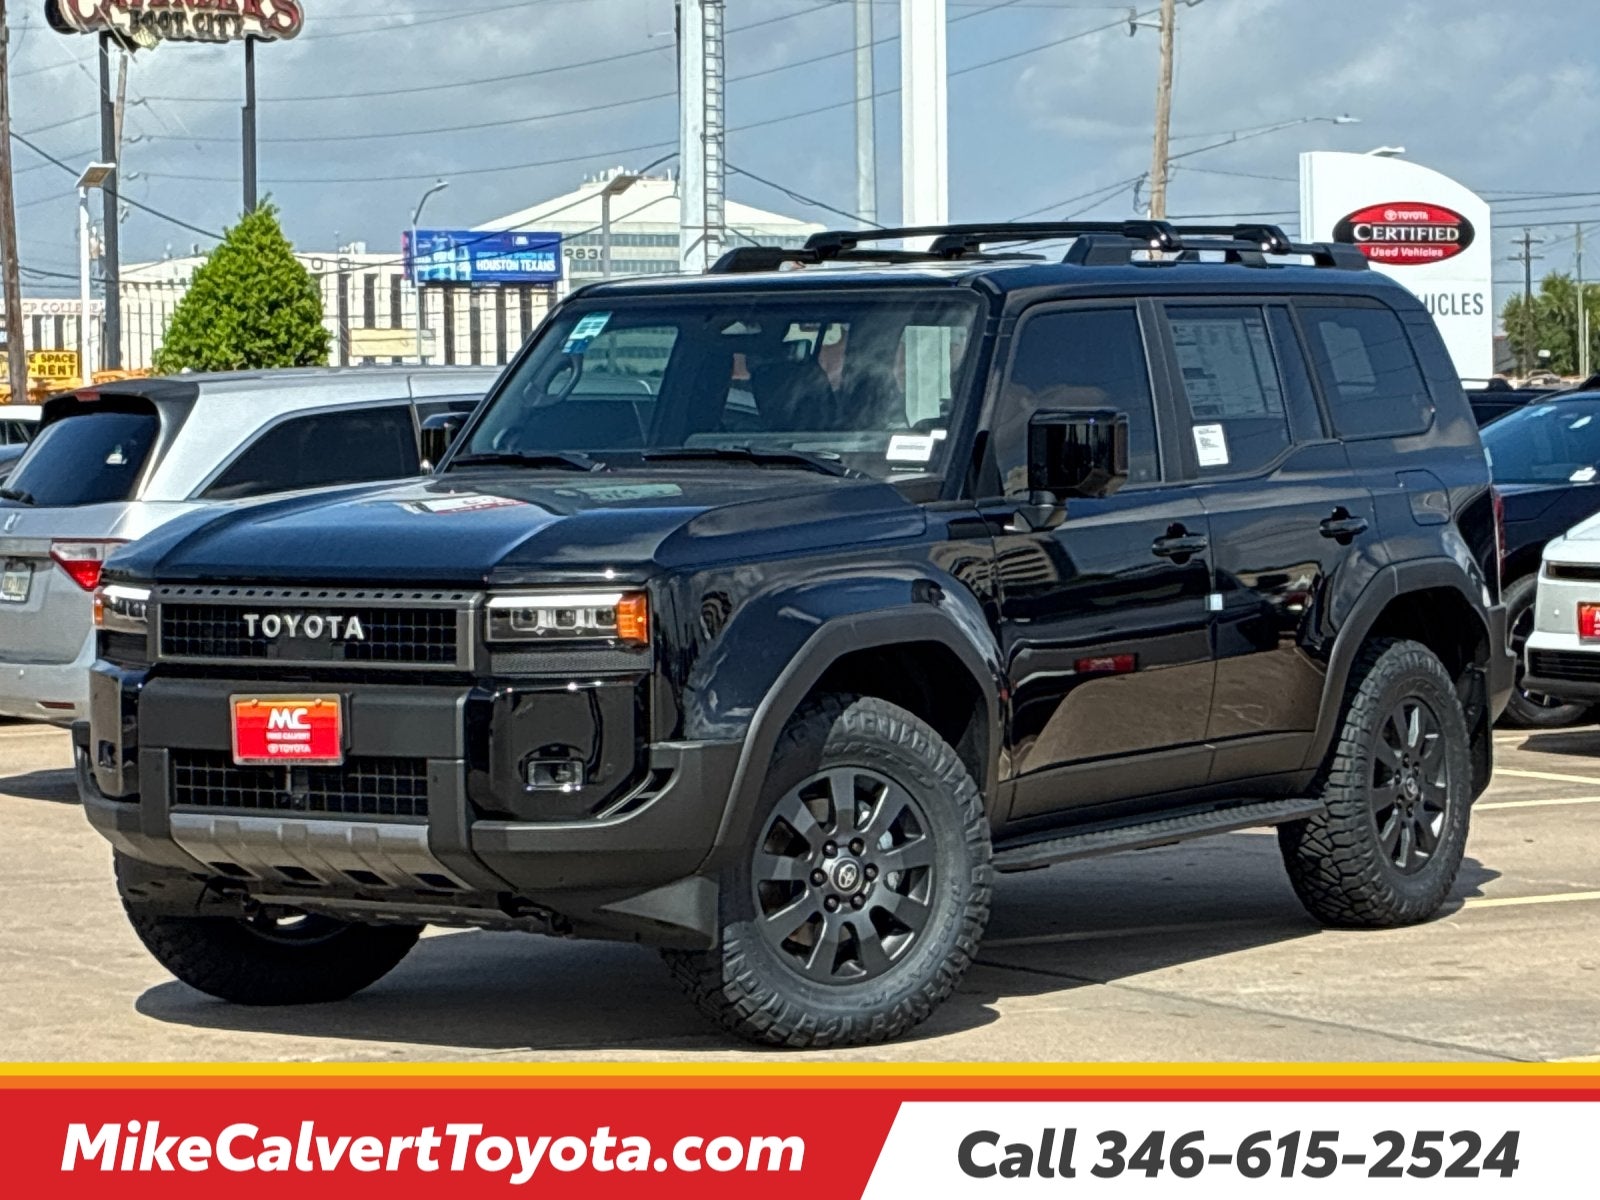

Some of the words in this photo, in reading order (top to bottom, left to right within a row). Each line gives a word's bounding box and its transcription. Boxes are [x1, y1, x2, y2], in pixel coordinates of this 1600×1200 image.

[129, 9, 187, 37] BOOT
[192, 12, 244, 38] CITY
[1398, 211, 1429, 220] TOYOTA
[1353, 223, 1459, 241] CERTIFIED
[1370, 247, 1398, 257] Used
[1400, 247, 1443, 257] Vehicles
[41, 302, 99, 314] COLLEE
[1424, 292, 1484, 316] ICLES
[41, 353, 76, 363] SPACE
[243, 614, 365, 640] TOYOTA
[267, 708, 312, 729] MC
[278, 744, 311, 753] TOYOTA
